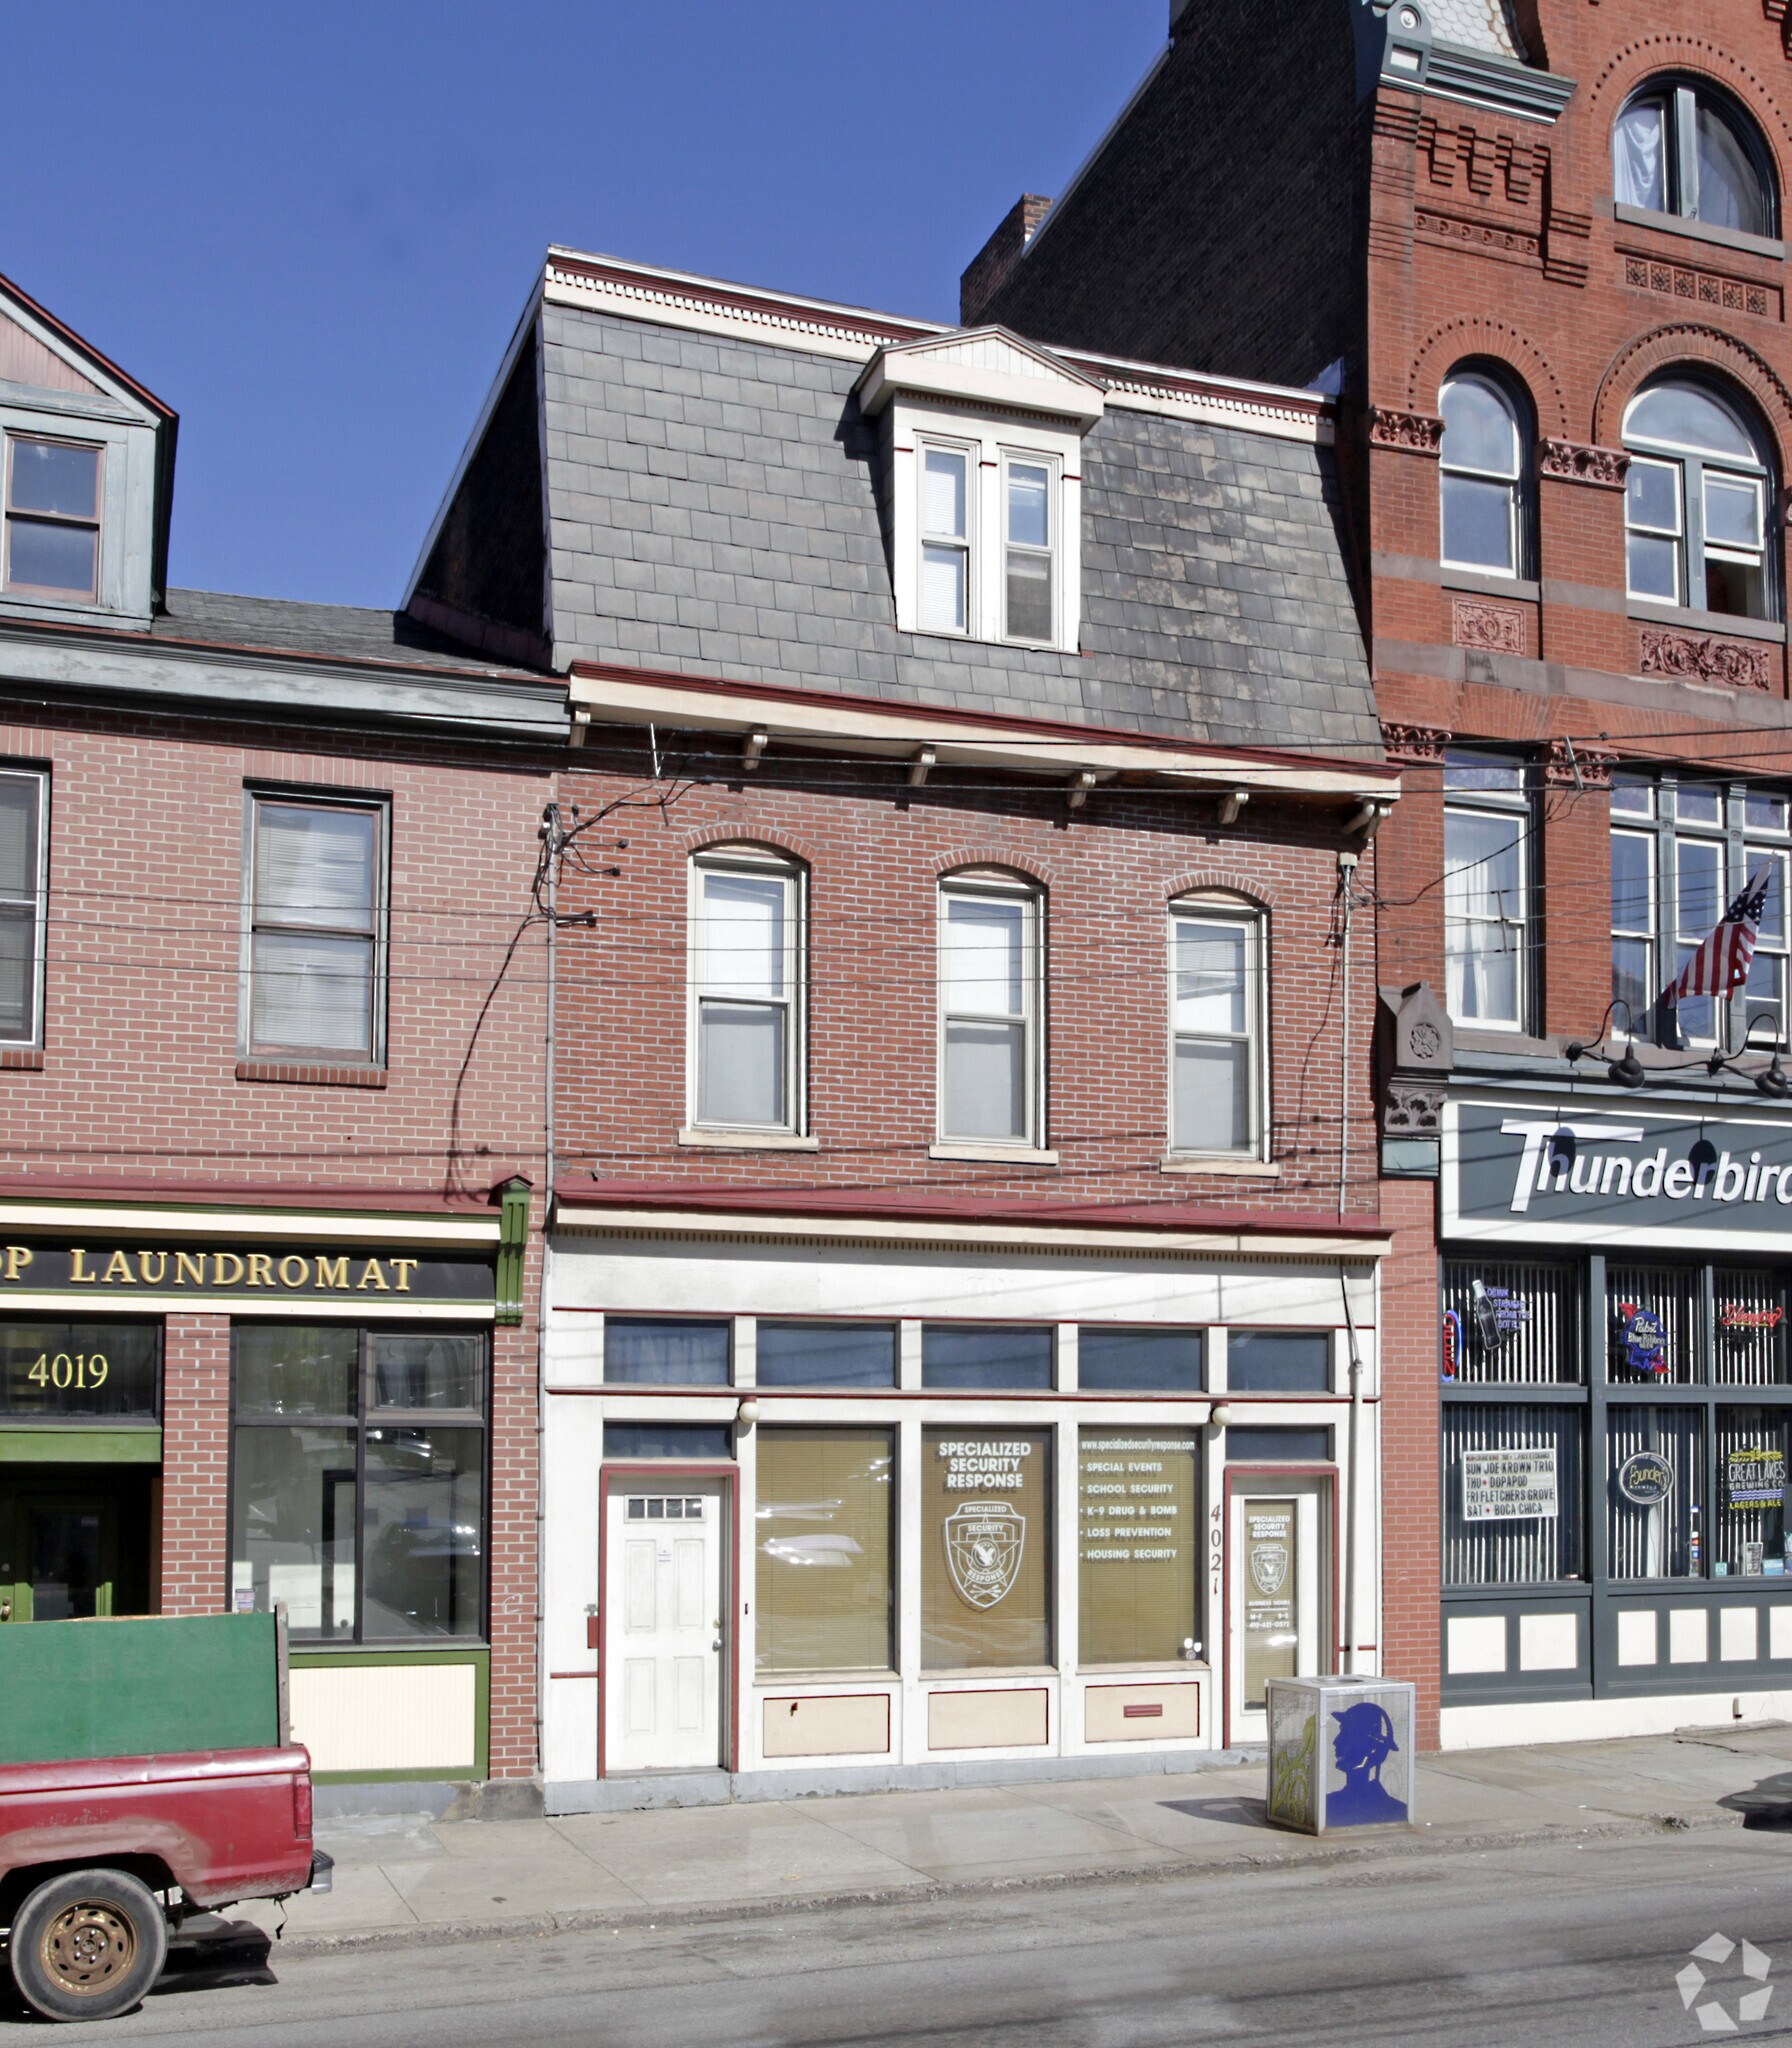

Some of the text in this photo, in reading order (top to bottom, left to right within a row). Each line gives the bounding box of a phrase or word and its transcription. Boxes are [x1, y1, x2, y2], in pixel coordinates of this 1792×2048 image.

[69, 1249, 418, 1292] LAUNDROMAT
[1635, 1316, 1657, 1333] Pabst
[1442, 1313, 1456, 1375] OPEN
[1627, 1332, 1666, 1345] Blue Ribbon
[28, 1353, 109, 1388] 4019
[939, 1442, 1031, 1456] SPECIALIZED
[1081, 1438, 1195, 1452] www.specializedsecurityresponse.com
[950, 1457, 1020, 1472] SECURITY
[1087, 1462, 1162, 1472] SPECIAL EVENTS
[1466, 1460, 1554, 1475] SUN JOE KROWN TRIO
[1729, 1461, 1785, 1482] GREAT LAKES
[947, 1473, 1023, 1488] RESPONSE
[1466, 1475, 1528, 1489] THU DOPAPOD
[1729, 1480, 1769, 1490] BREWING
[1087, 1484, 1173, 1494] SCHOOL SECURITY
[1467, 1489, 1554, 1502] FRI FLETCHERS GROVE
[964, 1505, 1007, 1514] SPECIALIZED
[1087, 1506, 1177, 1515] K-9 DRUG & BOMB
[1467, 1503, 1543, 1517] SAT BOCA CHICA
[1730, 1499, 1759, 1510] LAGERS
[1248, 1515, 1290, 1523] SPECIALIZED
[967, 1524, 1004, 1532] SECURITY
[1087, 1527, 1172, 1537] LOSS PREVENTION
[1252, 1530, 1287, 1538] RESPONSE
[1087, 1549, 1177, 1559] HOUSING SECURITY
[1210, 1504, 1221, 1595] 4021
[967, 1570, 1004, 1583] RESPONSE
